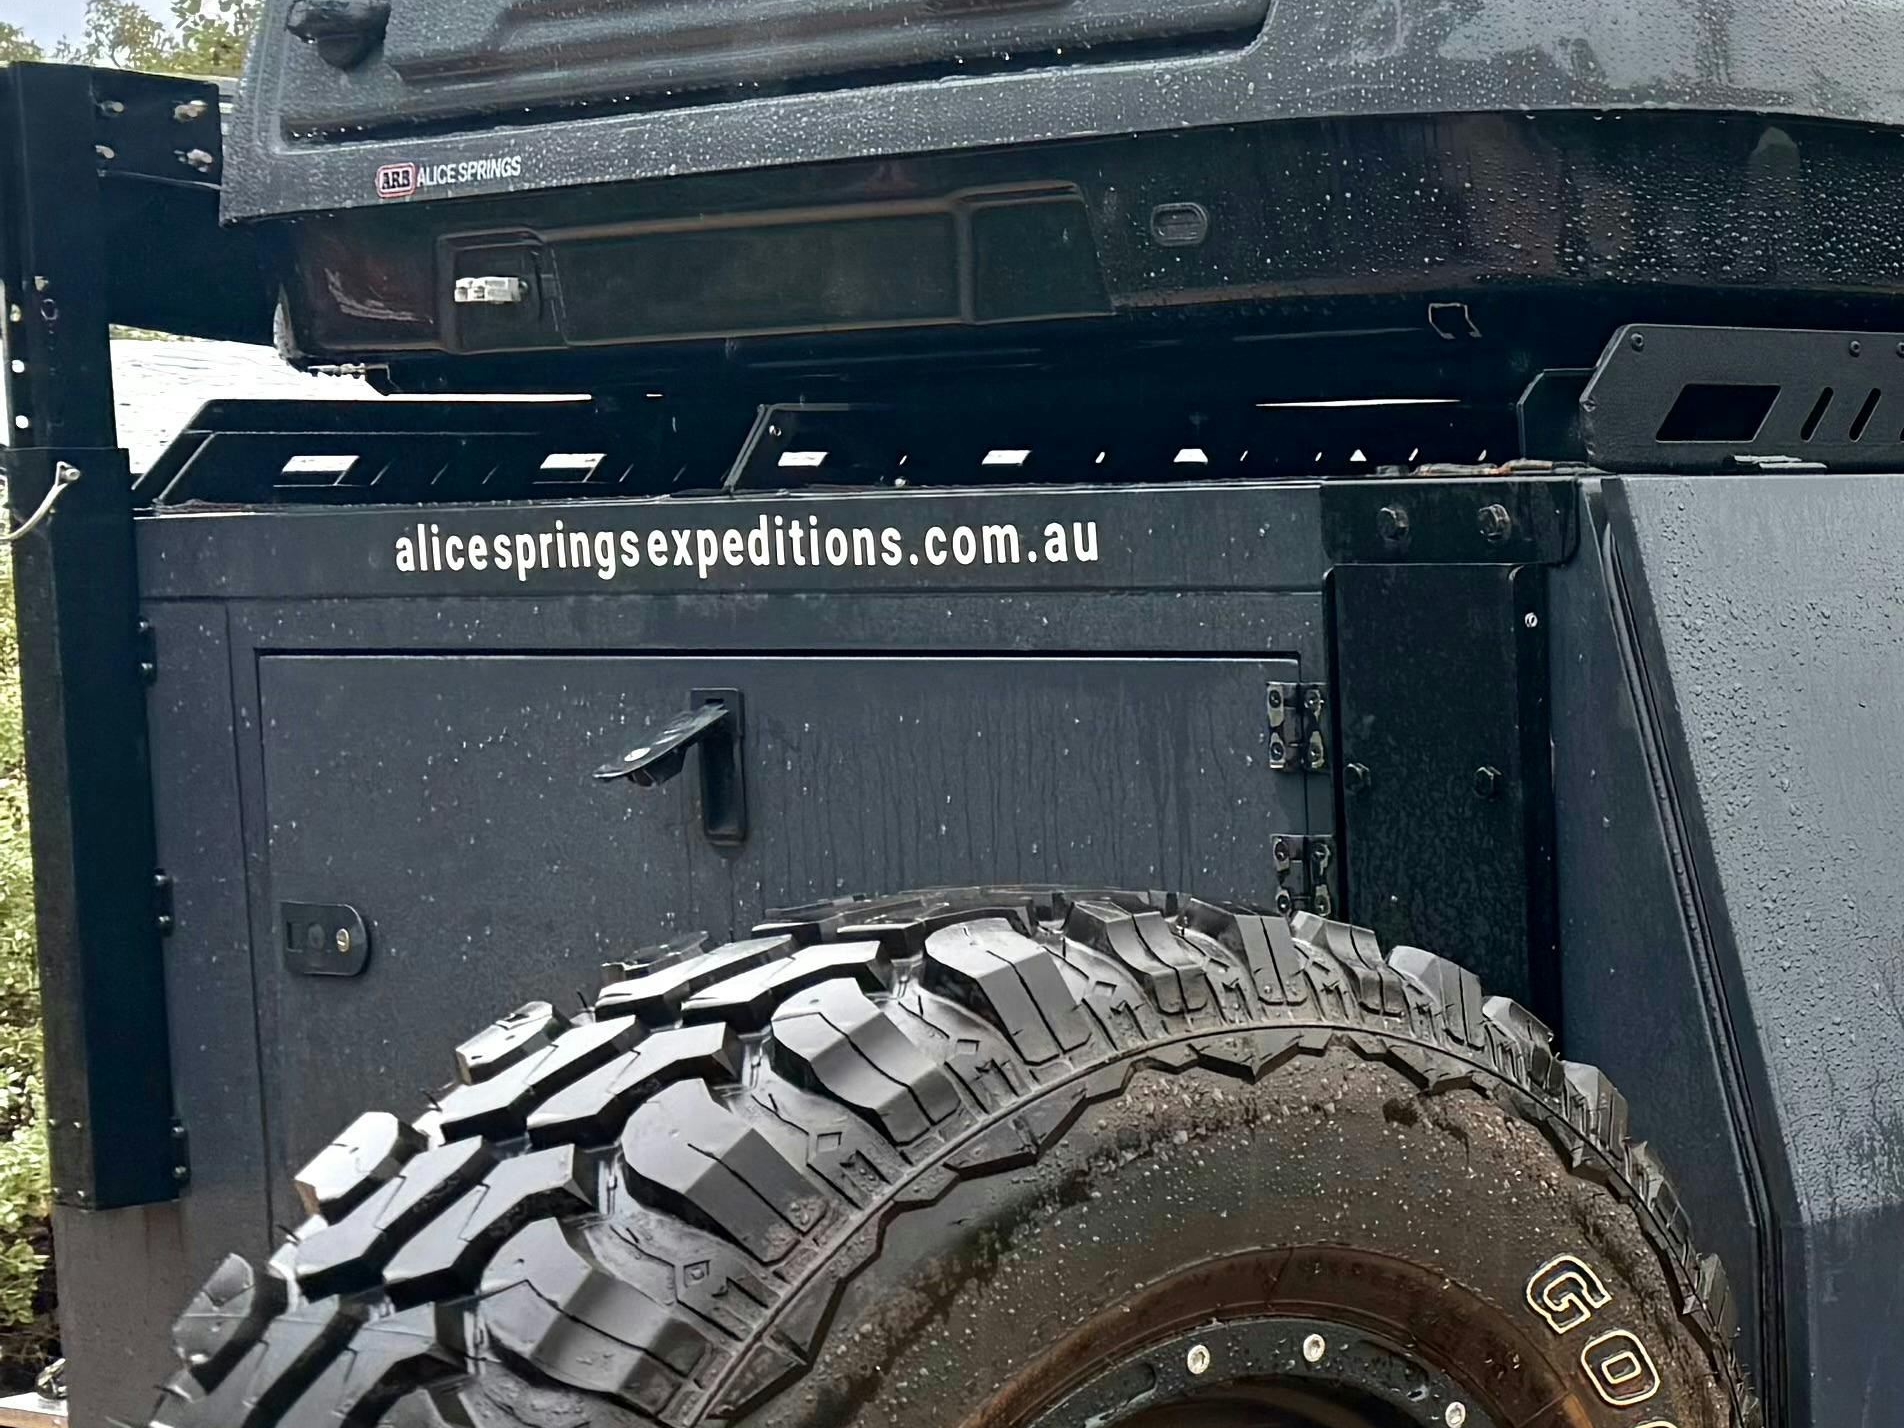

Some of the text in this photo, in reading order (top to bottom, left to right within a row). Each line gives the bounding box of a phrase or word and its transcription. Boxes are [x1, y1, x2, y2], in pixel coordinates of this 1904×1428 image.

[381, 155, 522, 190] ARB ALICE SPRINGS
[394, 514, 1101, 582] alicespringsexpeditions.com.au
